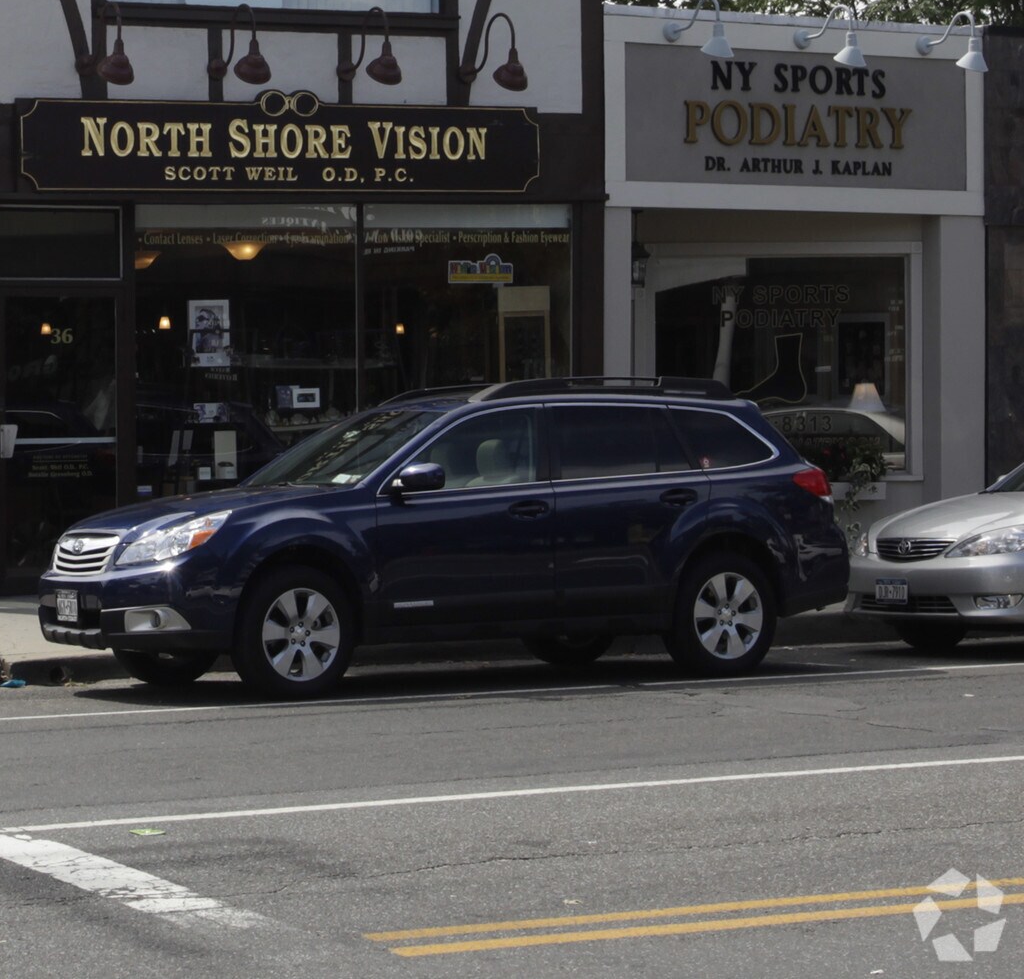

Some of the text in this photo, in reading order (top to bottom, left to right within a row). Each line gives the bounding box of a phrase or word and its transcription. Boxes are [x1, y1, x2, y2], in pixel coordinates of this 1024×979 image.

[711, 60, 886, 99] NY SPORTS
[683, 99, 913, 150] PODIATRY
[80, 116, 488, 161] NORTH SHORE VISION
[164, 166, 236, 181] SCOTT
[245, 167, 299, 182] WEIL
[374, 167, 415, 183] P.C.
[704, 156, 731, 171] DR.
[739, 158, 804, 174] ARTHUR
[831, 160, 893, 176] KAPLAN
[143, 232, 174, 245] Contact
[177, 232, 204, 245] Lenses
[213, 232, 233, 245] Laser
[458, 232, 503, 248] Perscription
[503, 232, 510, 244] &
[511, 231, 539, 244] Fashion
[540, 231, 570, 247] Eyewear
[752, 284, 850, 304] SPORTS
[721, 308, 843, 328] PODIATRY
[50, 327, 74, 345] 36
